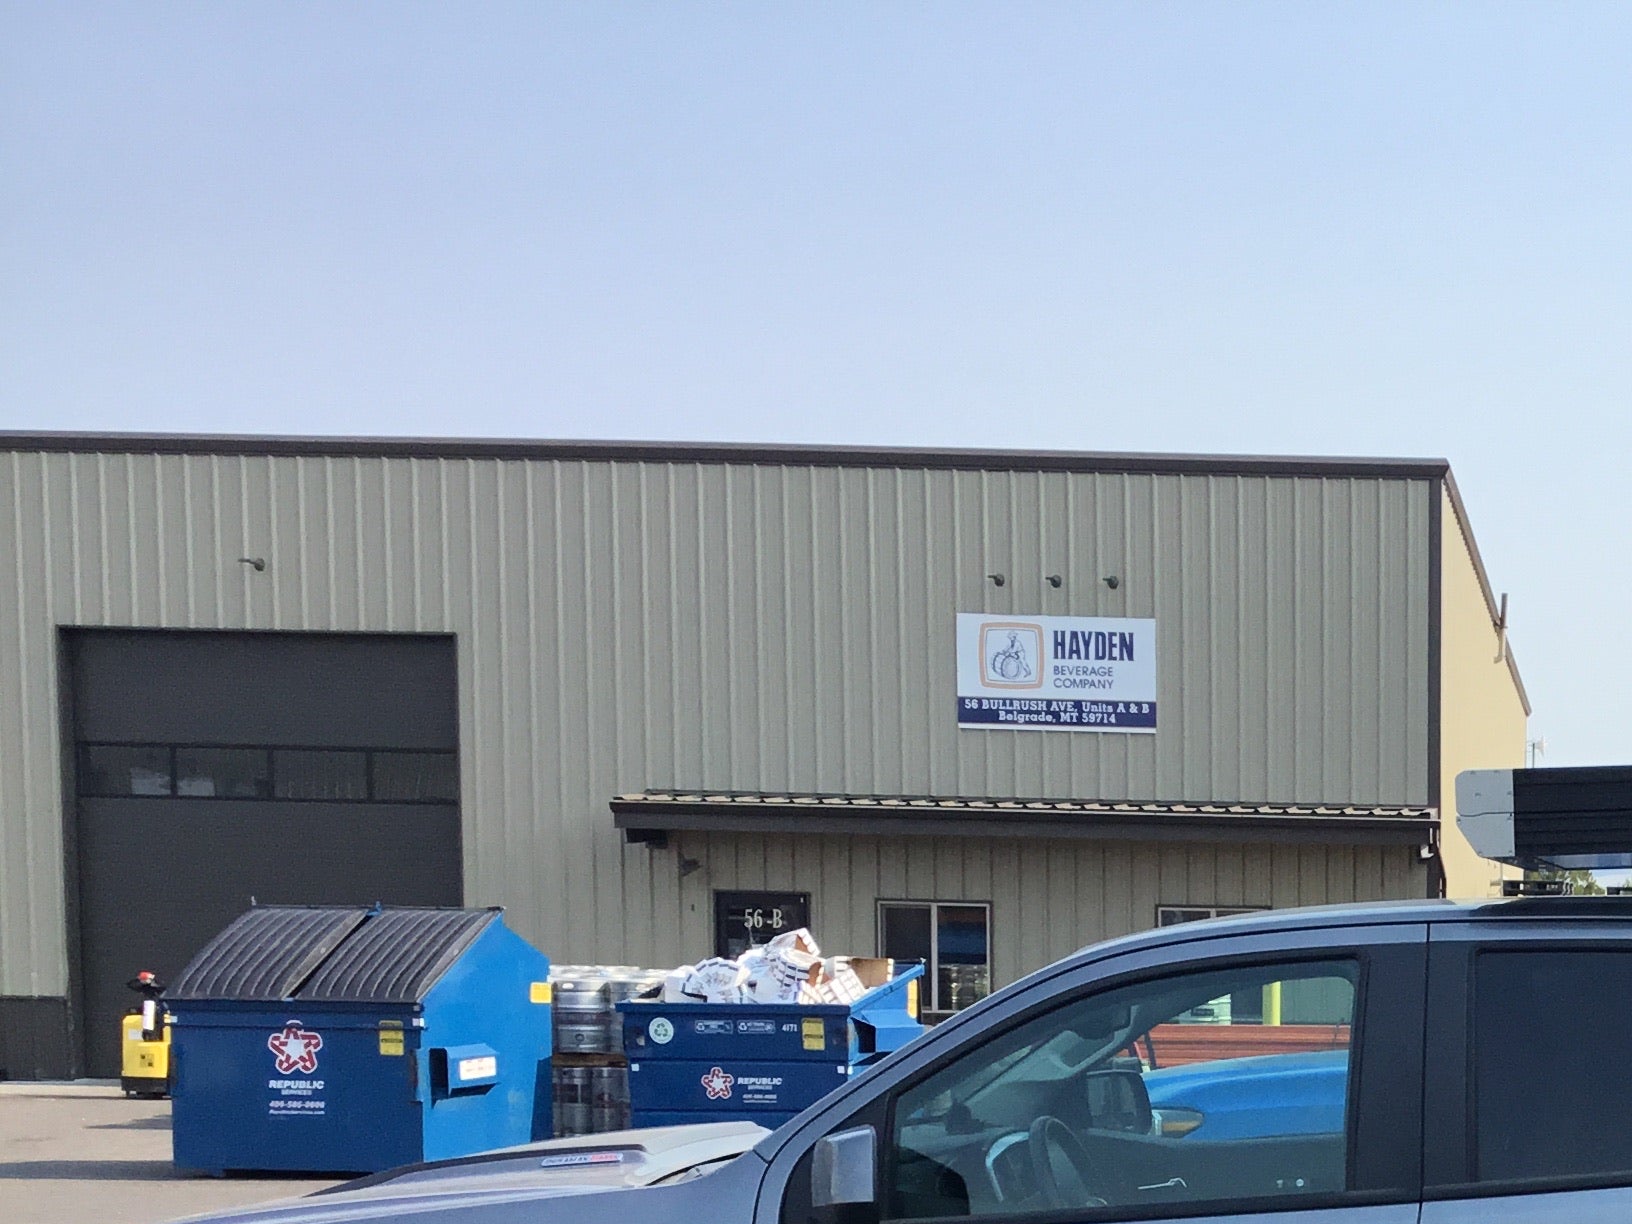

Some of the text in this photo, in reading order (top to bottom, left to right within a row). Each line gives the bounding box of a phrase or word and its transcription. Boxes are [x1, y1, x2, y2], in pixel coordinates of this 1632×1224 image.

[1053, 630, 1134, 661] HAYDEN
[1053, 665, 1113, 677] BEVERAGE
[1053, 677, 1114, 689] COMPANY
[964, 699, 979, 709] 56
[981, 699, 1047, 711] BULLRUSH
[1081, 702, 1114, 713] Units
[1116, 703, 1126, 713] A
[1129, 703, 1139, 714] &
[1141, 703, 1150, 713] B
[1060, 712, 1079, 723] MT
[1081, 713, 1116, 724] 59714
[268, 1079, 325, 1089] REPUBLIC
[737, 1077, 783, 1085] REPUBLIC
